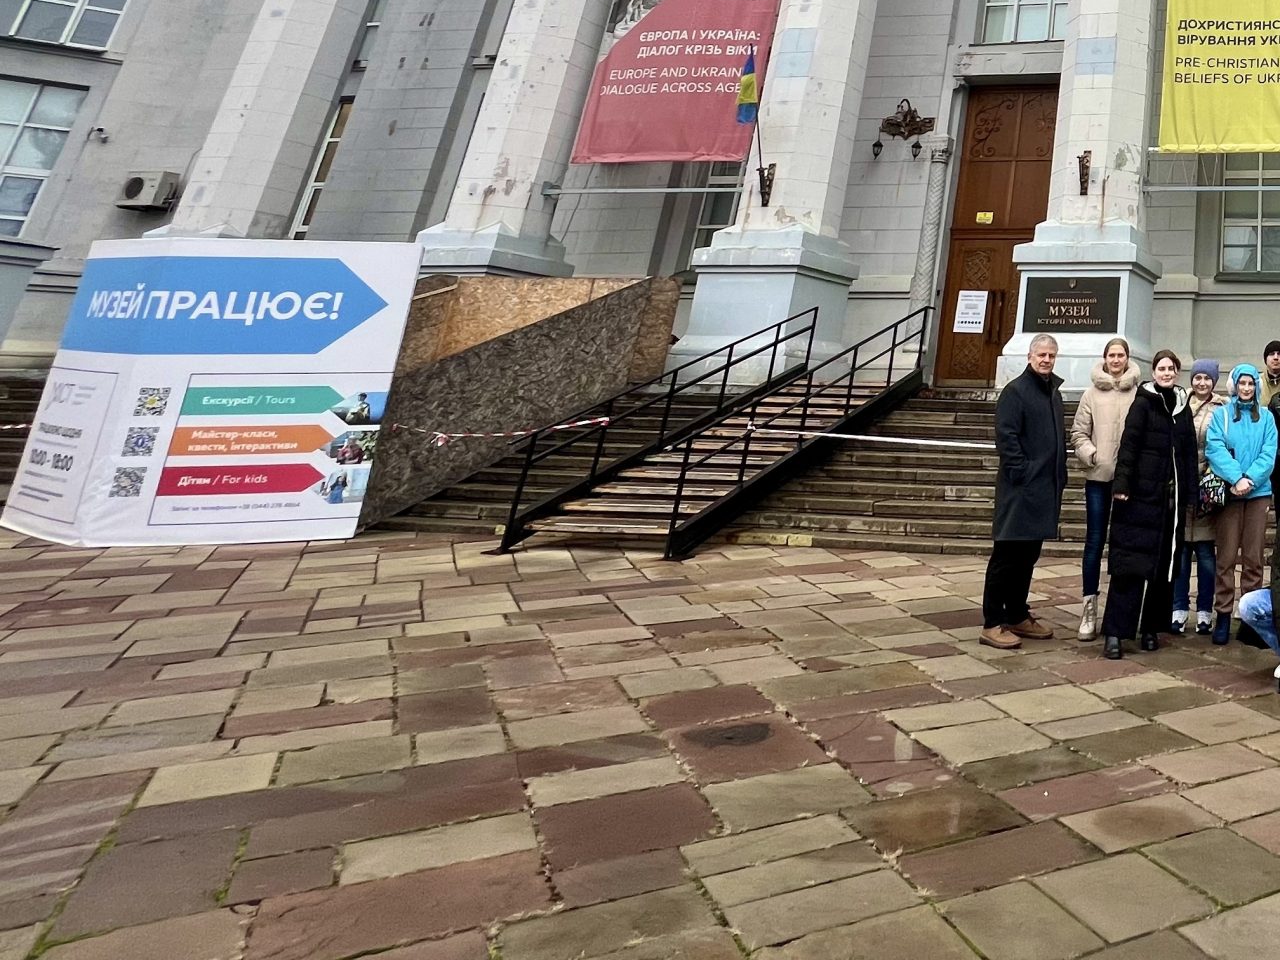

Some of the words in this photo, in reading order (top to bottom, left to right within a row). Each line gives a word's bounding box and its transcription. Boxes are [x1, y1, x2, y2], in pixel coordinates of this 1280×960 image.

[639, 30, 689, 42] ЄВРОПА
[691, 30, 696, 41] І
[700, 28, 761, 41] УКРАЇНА:
[1177, 34, 1256, 46] ВІРУВАННЯ
[636, 45, 683, 59] ДІАЛОГ
[685, 44, 722, 56] КРІЗЬ
[726, 45, 758, 56] ВІКИ
[1175, 56, 1280, 69] PRE-CHRISTIAN
[609, 67, 657, 80] EUROPE
[659, 67, 688, 79] AND
[691, 66, 743, 78] UKRAIN
[1174, 72, 1229, 84] BELIEFS
[1233, 73, 1253, 84] OF
[660, 82, 712, 94] ACROSS
[86, 282, 145, 319] МУЗЕЙ
[142, 290, 344, 326] ПРАЦЮЄ!
[265, 396, 296, 404] Tours
[221, 475, 242, 484] For
[244, 474, 268, 484] kids
